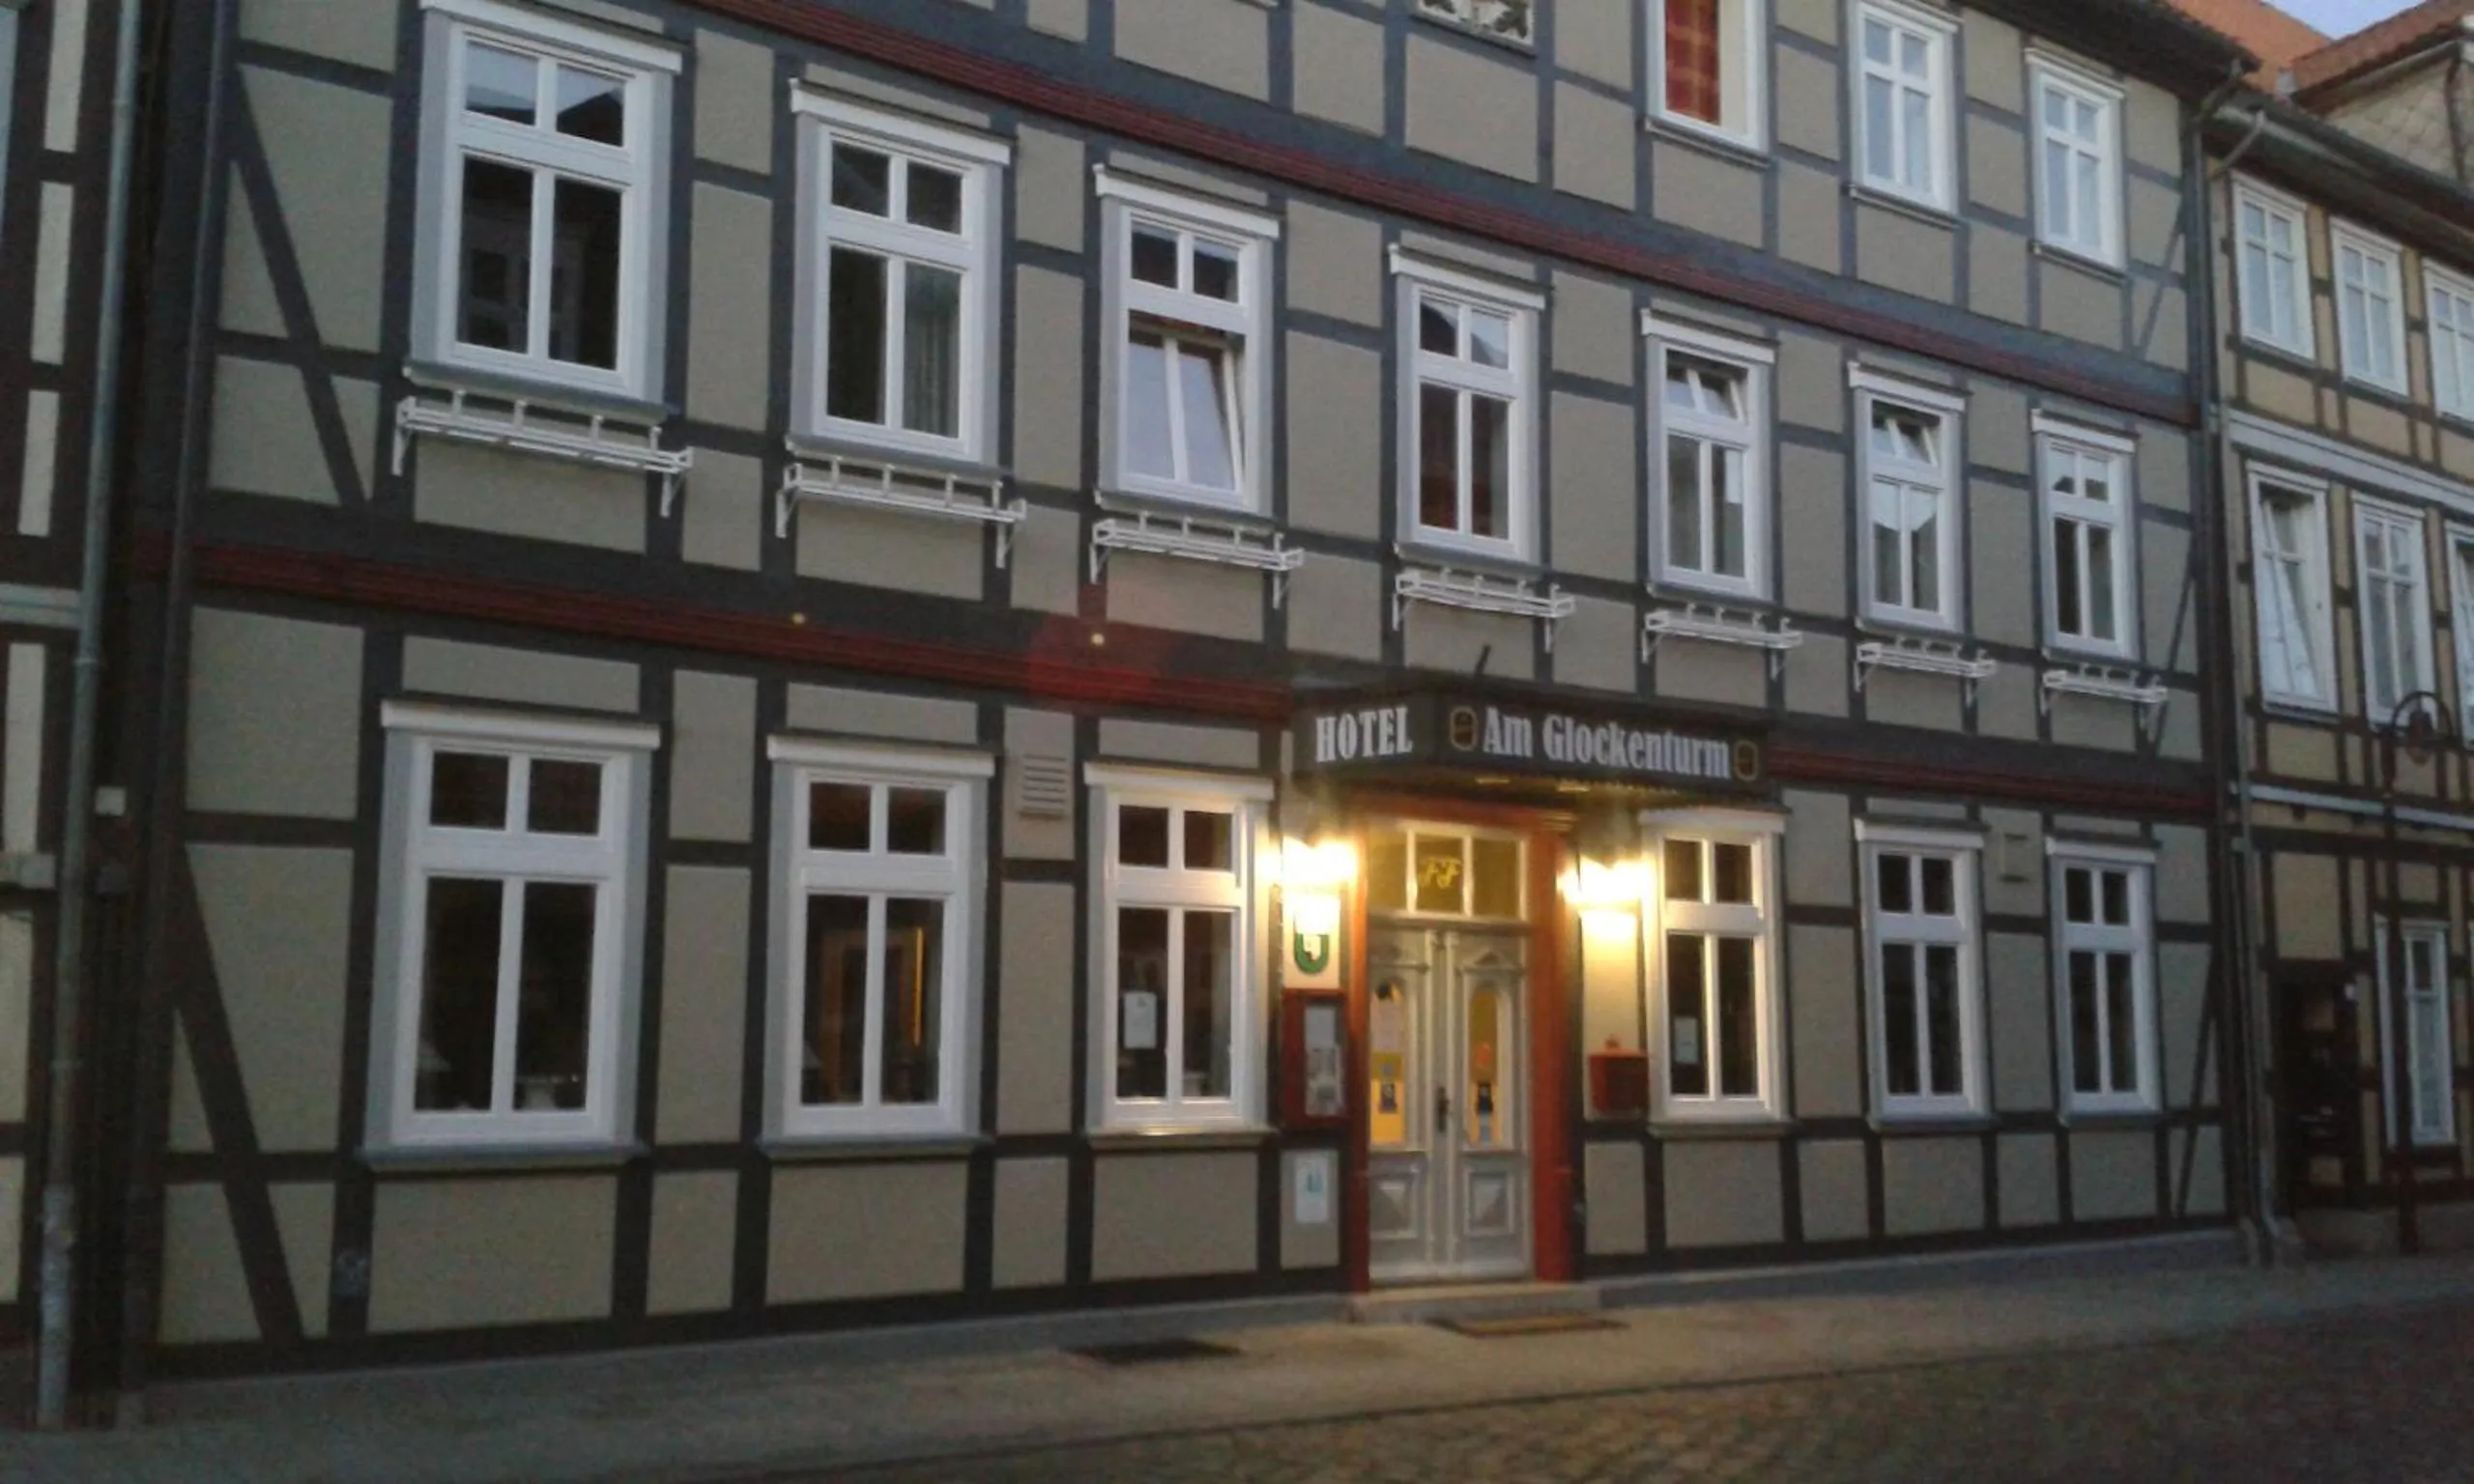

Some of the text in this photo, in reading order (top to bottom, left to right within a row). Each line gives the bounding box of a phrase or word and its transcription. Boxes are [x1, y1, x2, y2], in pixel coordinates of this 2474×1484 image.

[1316, 705, 1413, 762] HOTEL
[1482, 706, 1732, 779] Am Glockenturm
